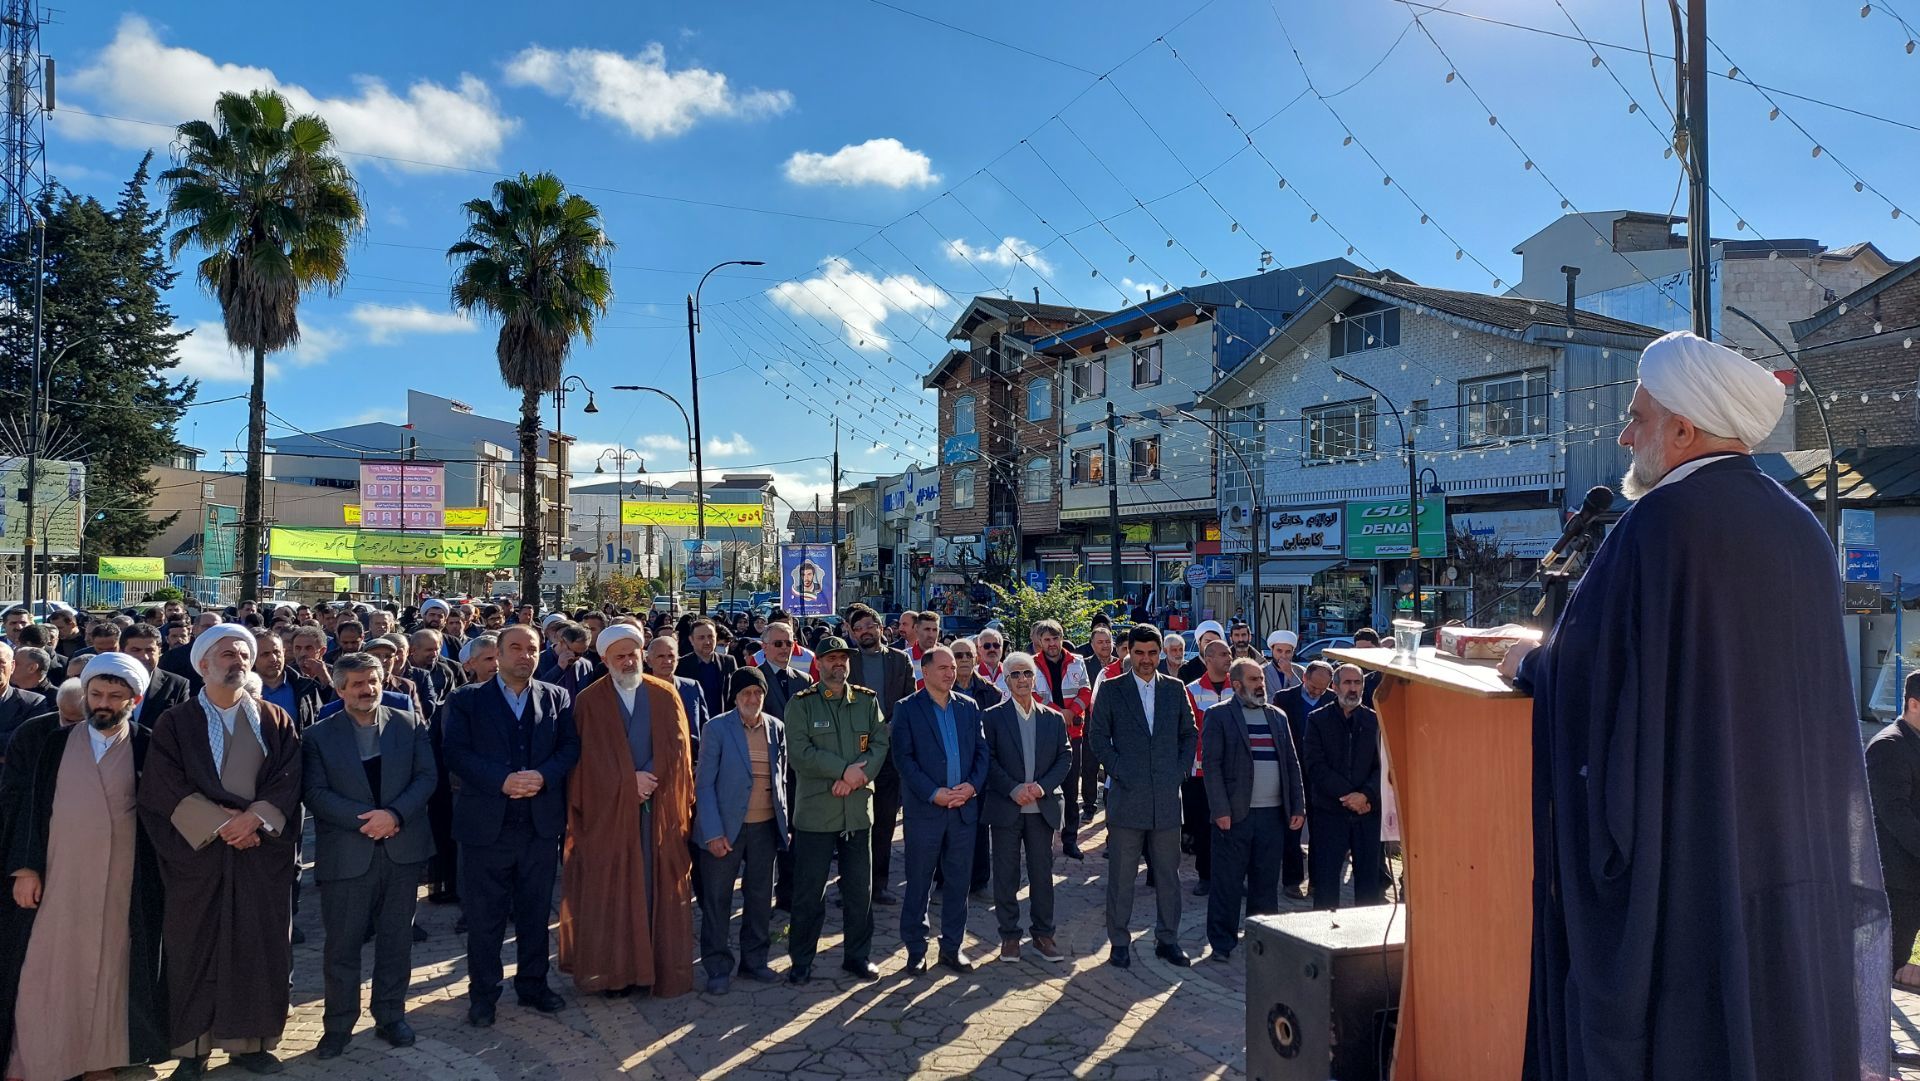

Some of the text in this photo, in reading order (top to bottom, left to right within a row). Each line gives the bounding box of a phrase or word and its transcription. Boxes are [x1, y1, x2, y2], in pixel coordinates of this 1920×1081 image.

[738, 513, 753, 522] دی
[1272, 511, 1337, 530] لوازم خانگی
[1283, 531, 1324, 551] کامیابی
[425, 544, 444, 558] دی
[444, 541, 469, 560] نهم
[1031, 573, 1039, 586] P
